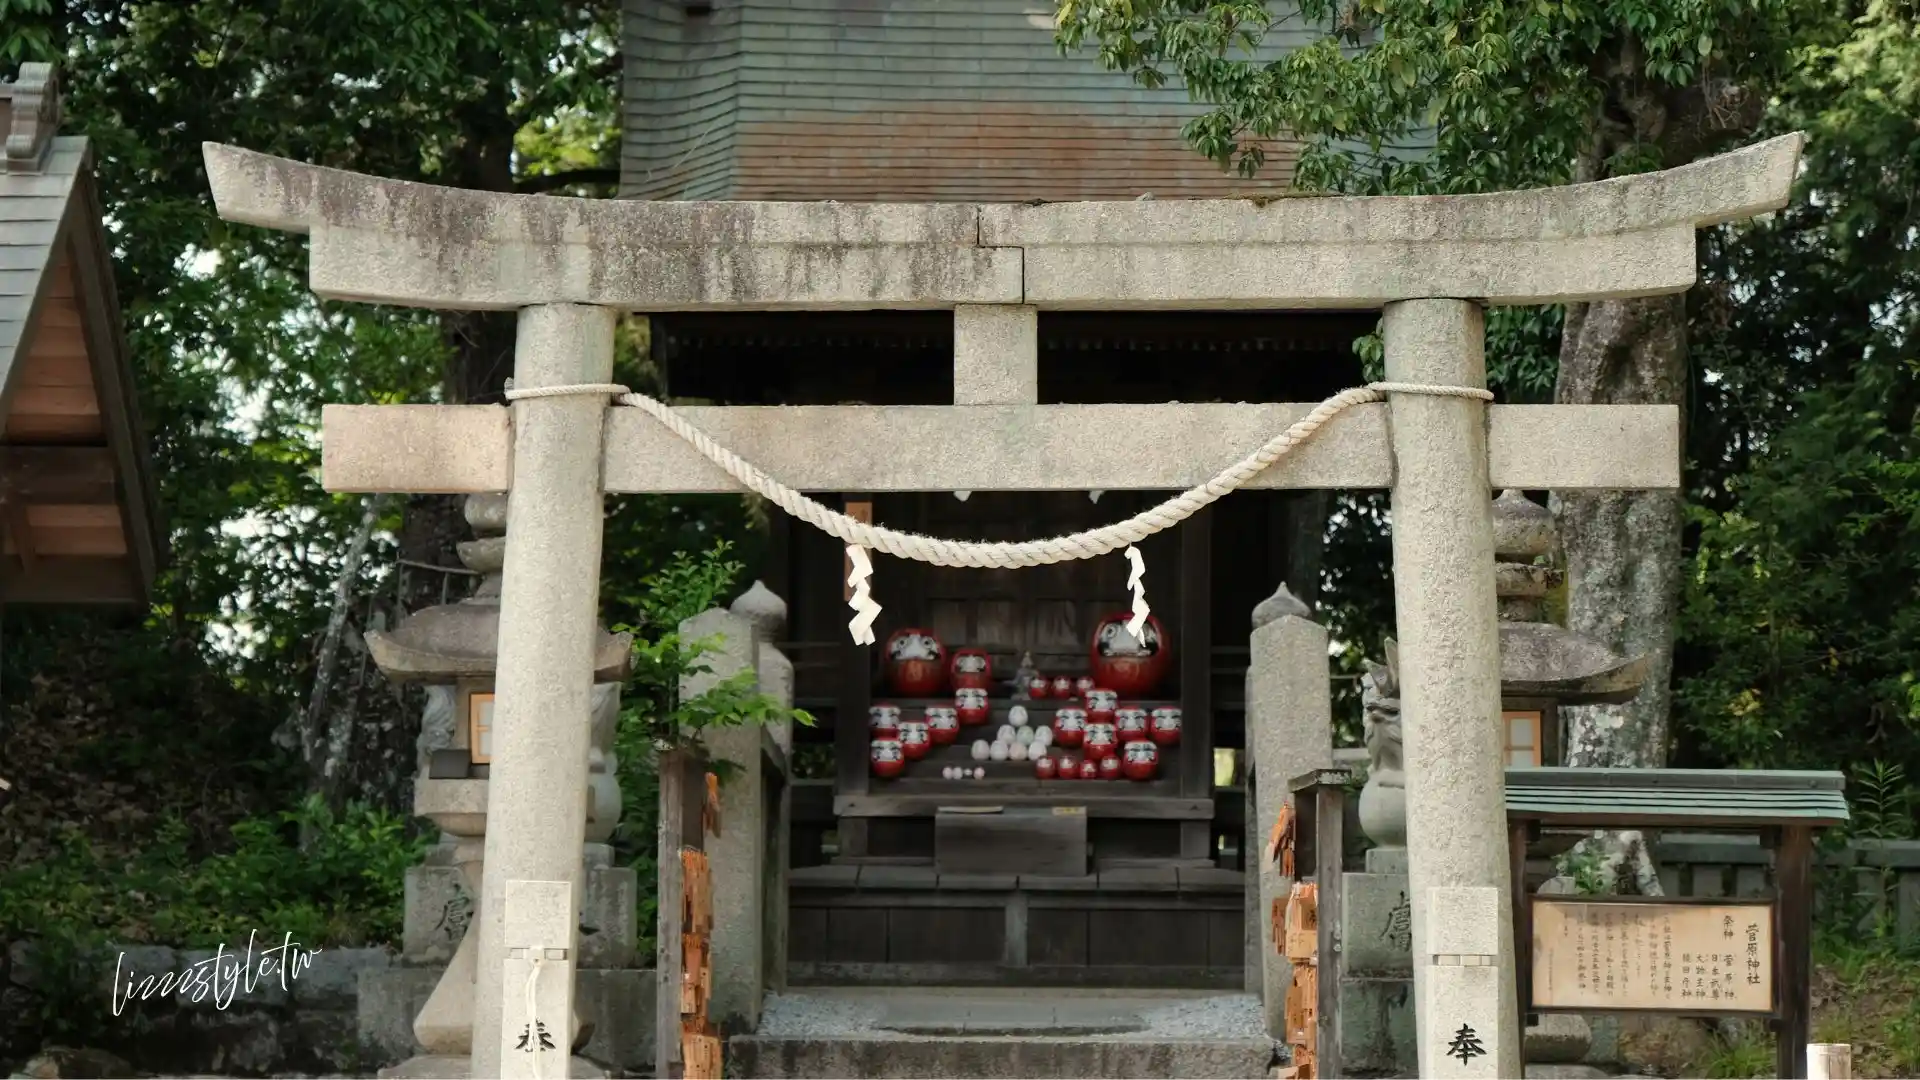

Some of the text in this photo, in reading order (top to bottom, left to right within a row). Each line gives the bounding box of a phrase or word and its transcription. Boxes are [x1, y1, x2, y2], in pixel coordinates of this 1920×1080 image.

[1745, 922, 1761, 985] 菅原神社
[1446, 1023, 1487, 1066] 奉
